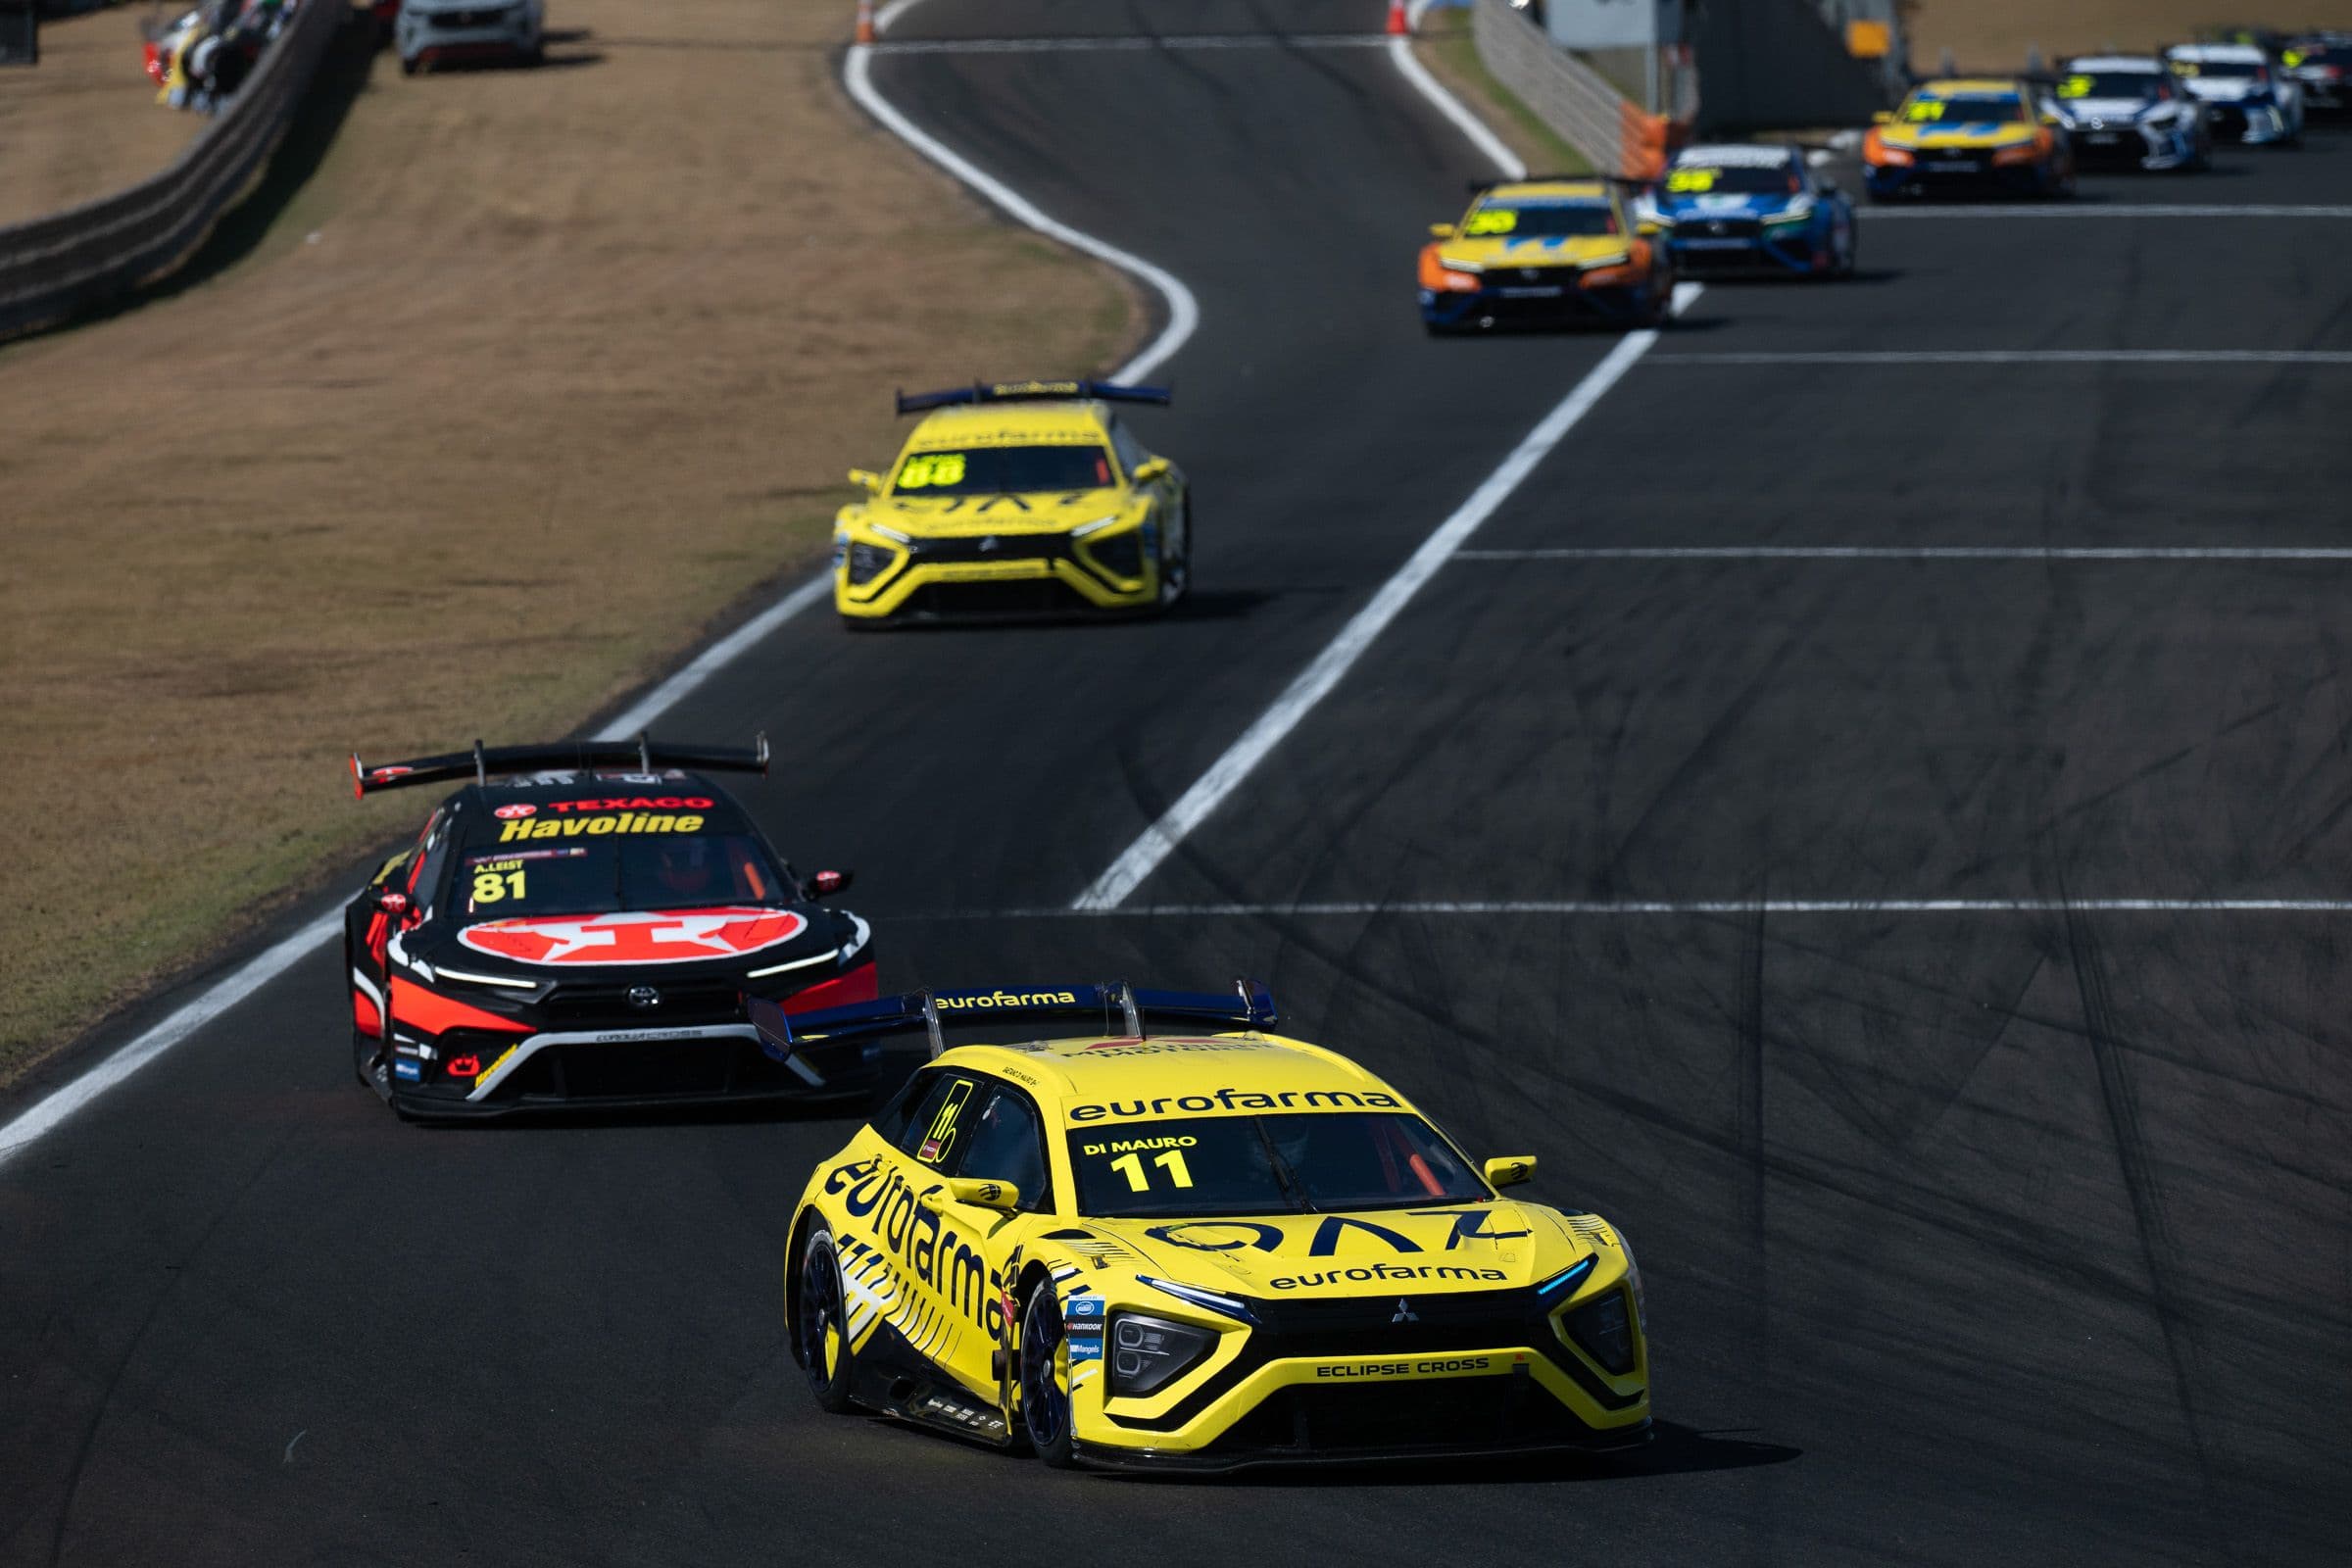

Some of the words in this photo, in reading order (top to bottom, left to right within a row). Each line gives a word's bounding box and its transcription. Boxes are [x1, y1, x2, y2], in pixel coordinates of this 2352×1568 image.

[548, 797, 715, 813] TEXACO
[498, 811, 706, 843] Havoline
[473, 858, 524, 874] A.LEIST
[471, 869, 526, 904] 81
[935, 990, 1076, 1009] eurofarma
[1069, 1087, 1403, 1122] eurofarma
[1083, 1143, 1107, 1156] DI
[1110, 1136, 1199, 1153] MAURO
[1109, 1149, 1194, 1193] 11
[825, 1159, 1004, 1342] eurofarma
[1269, 1262, 1508, 1291] eurofarma
[1316, 1363, 1409, 1378] ECLIPSE
[1417, 1357, 1490, 1374] CROSS
